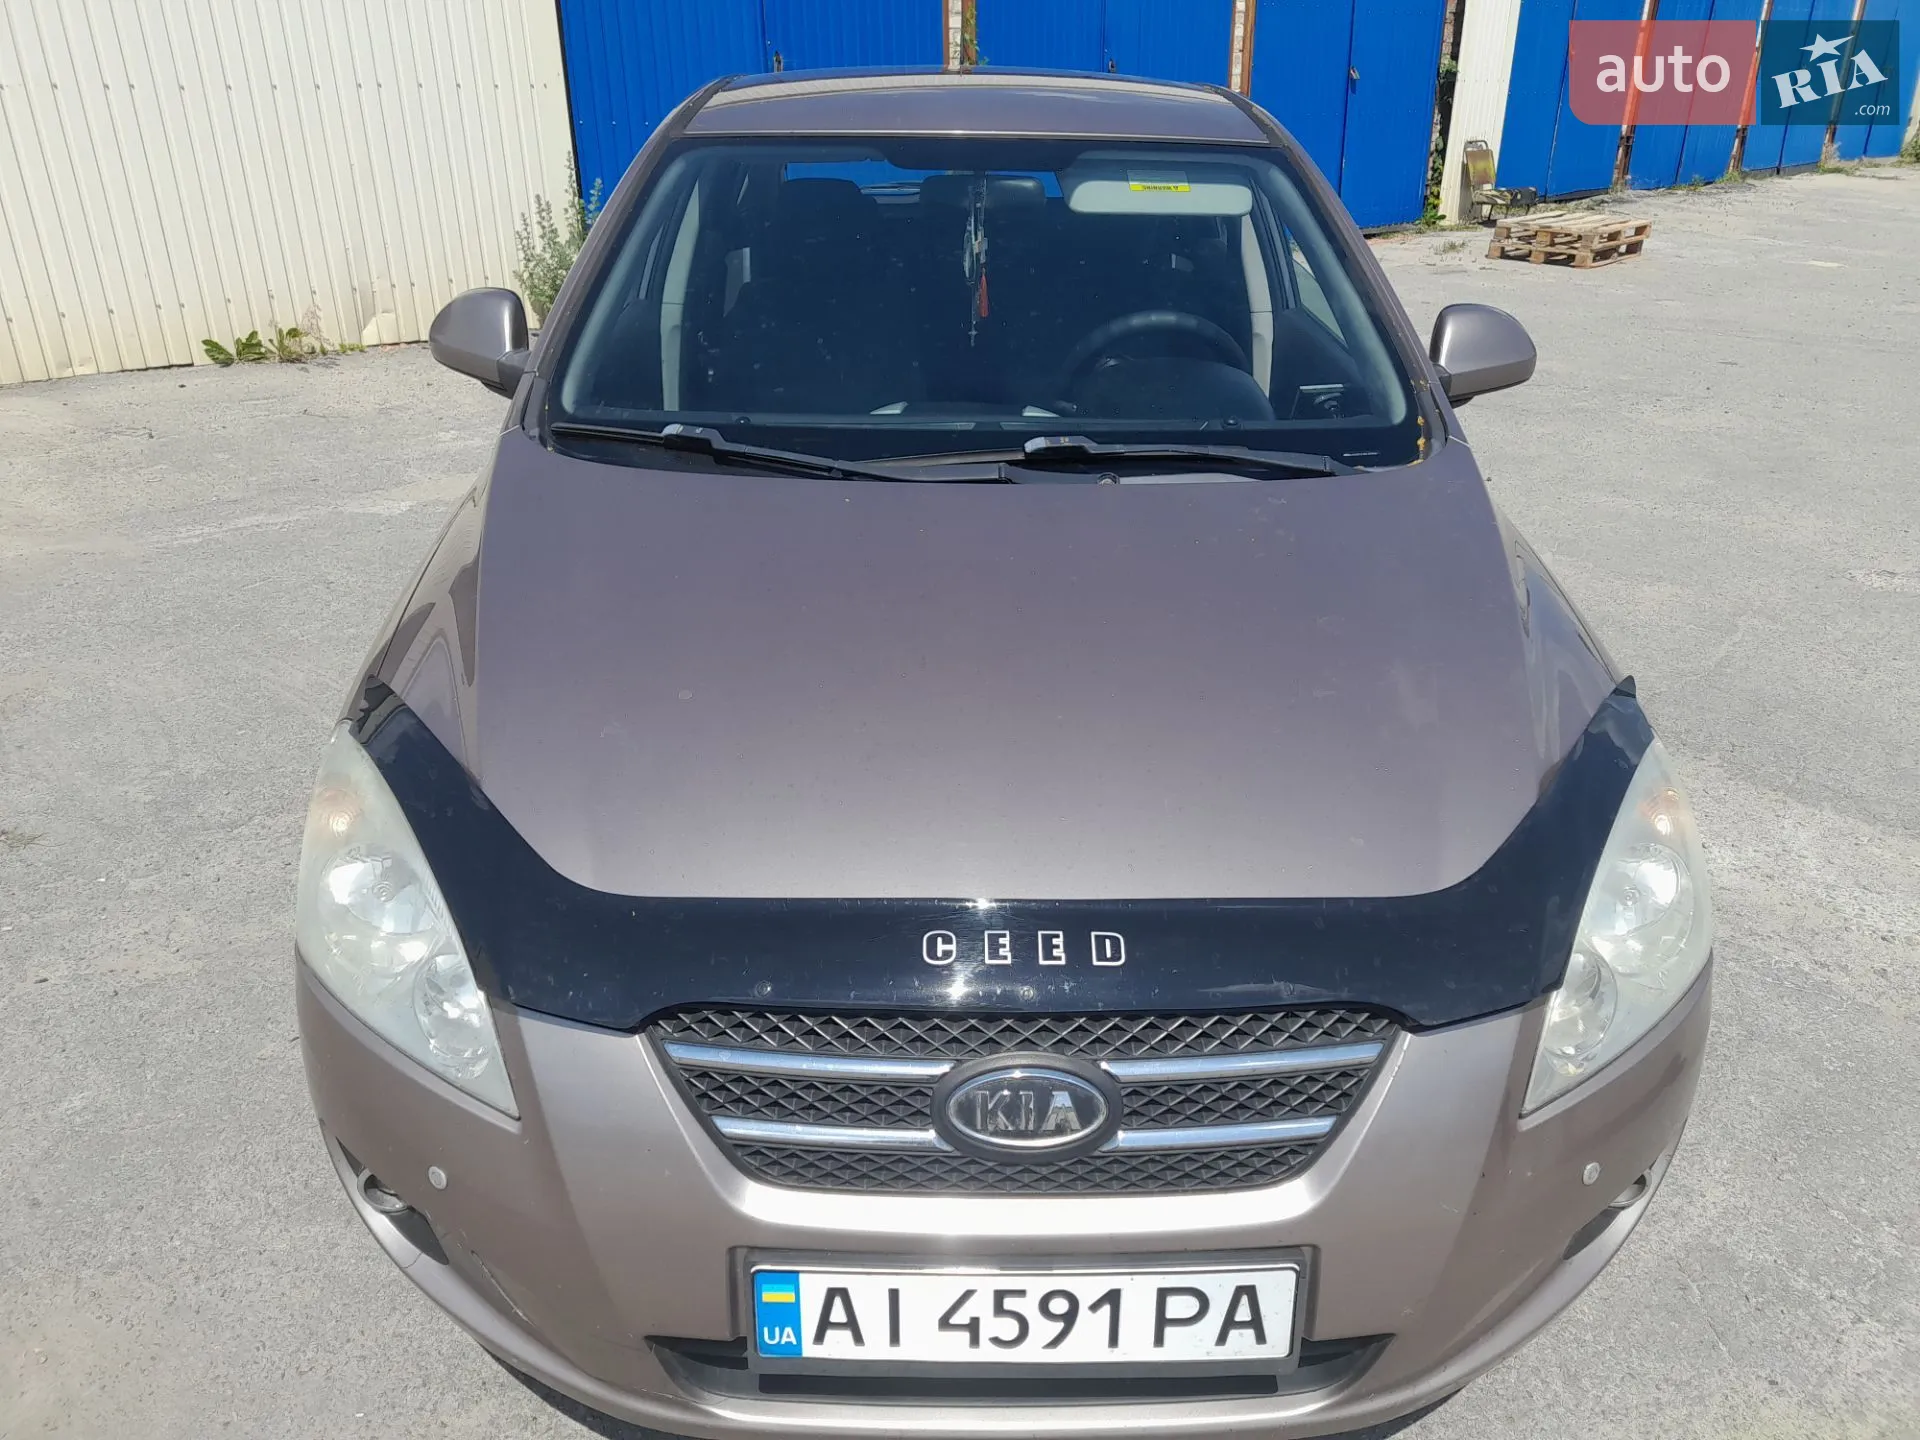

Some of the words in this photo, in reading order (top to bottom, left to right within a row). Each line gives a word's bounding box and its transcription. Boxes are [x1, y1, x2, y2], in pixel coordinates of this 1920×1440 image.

[922, 930, 1126, 966] CEED
[975, 1091, 1082, 1131] KIA
[763, 1326, 798, 1345] UA
[812, 1286, 901, 1348] AI
[937, 1287, 1123, 1350] 4591
[1152, 1284, 1269, 1348] PA
